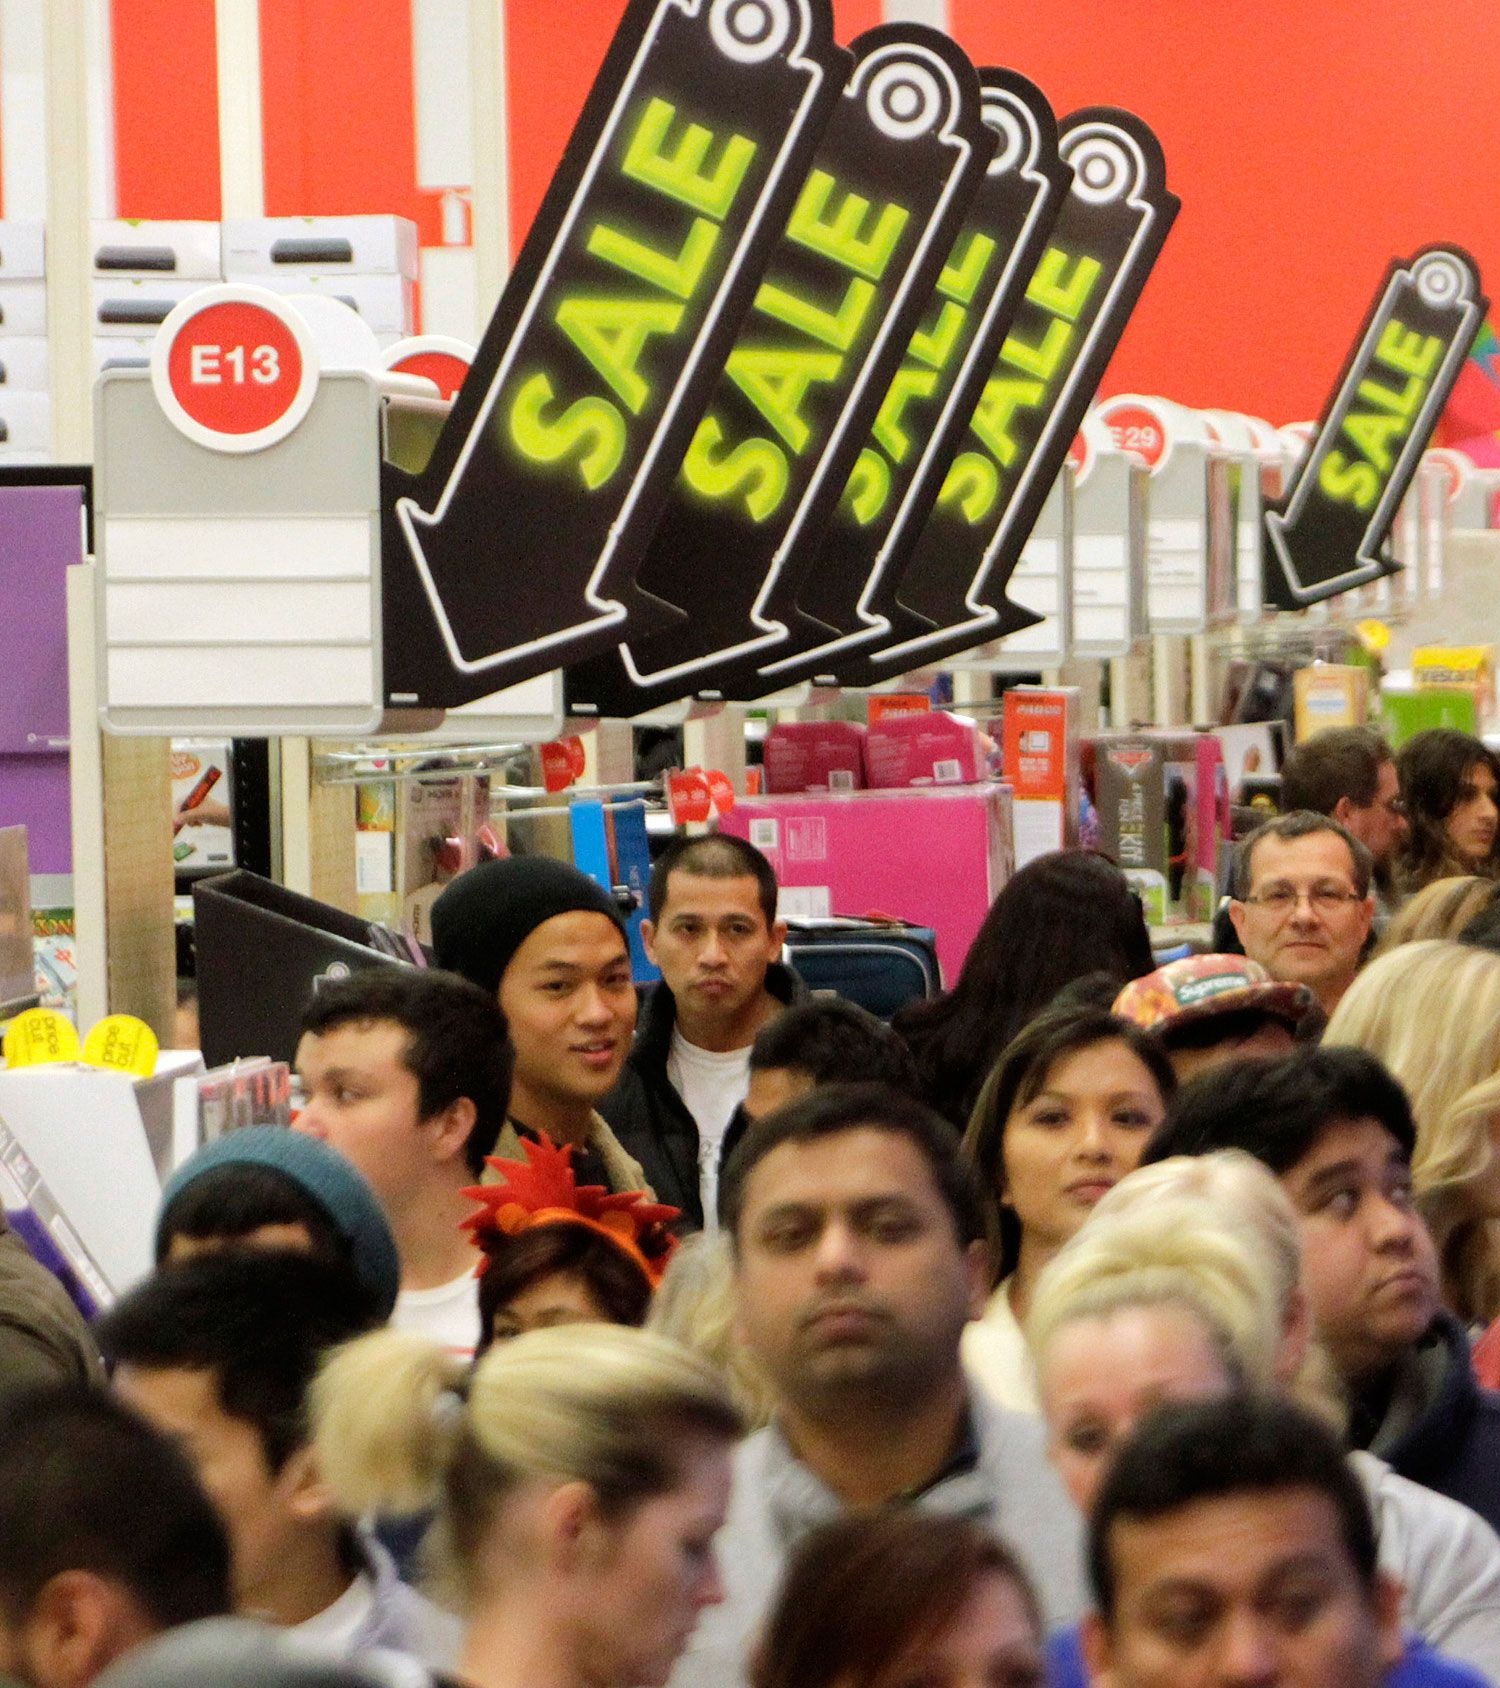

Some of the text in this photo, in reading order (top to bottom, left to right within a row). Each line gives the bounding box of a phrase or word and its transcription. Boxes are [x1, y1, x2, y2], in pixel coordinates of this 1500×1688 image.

[507, 98, 757, 489] SALE
[191, 344, 281, 385] E13
[682, 169, 909, 522] SALE
[1318, 320, 1443, 509] SALE
[29, 1017, 44, 1043] cut
[45, 1016, 59, 1055] price
[102, 1025, 120, 1064] price
[117, 1042, 133, 1067] cut
